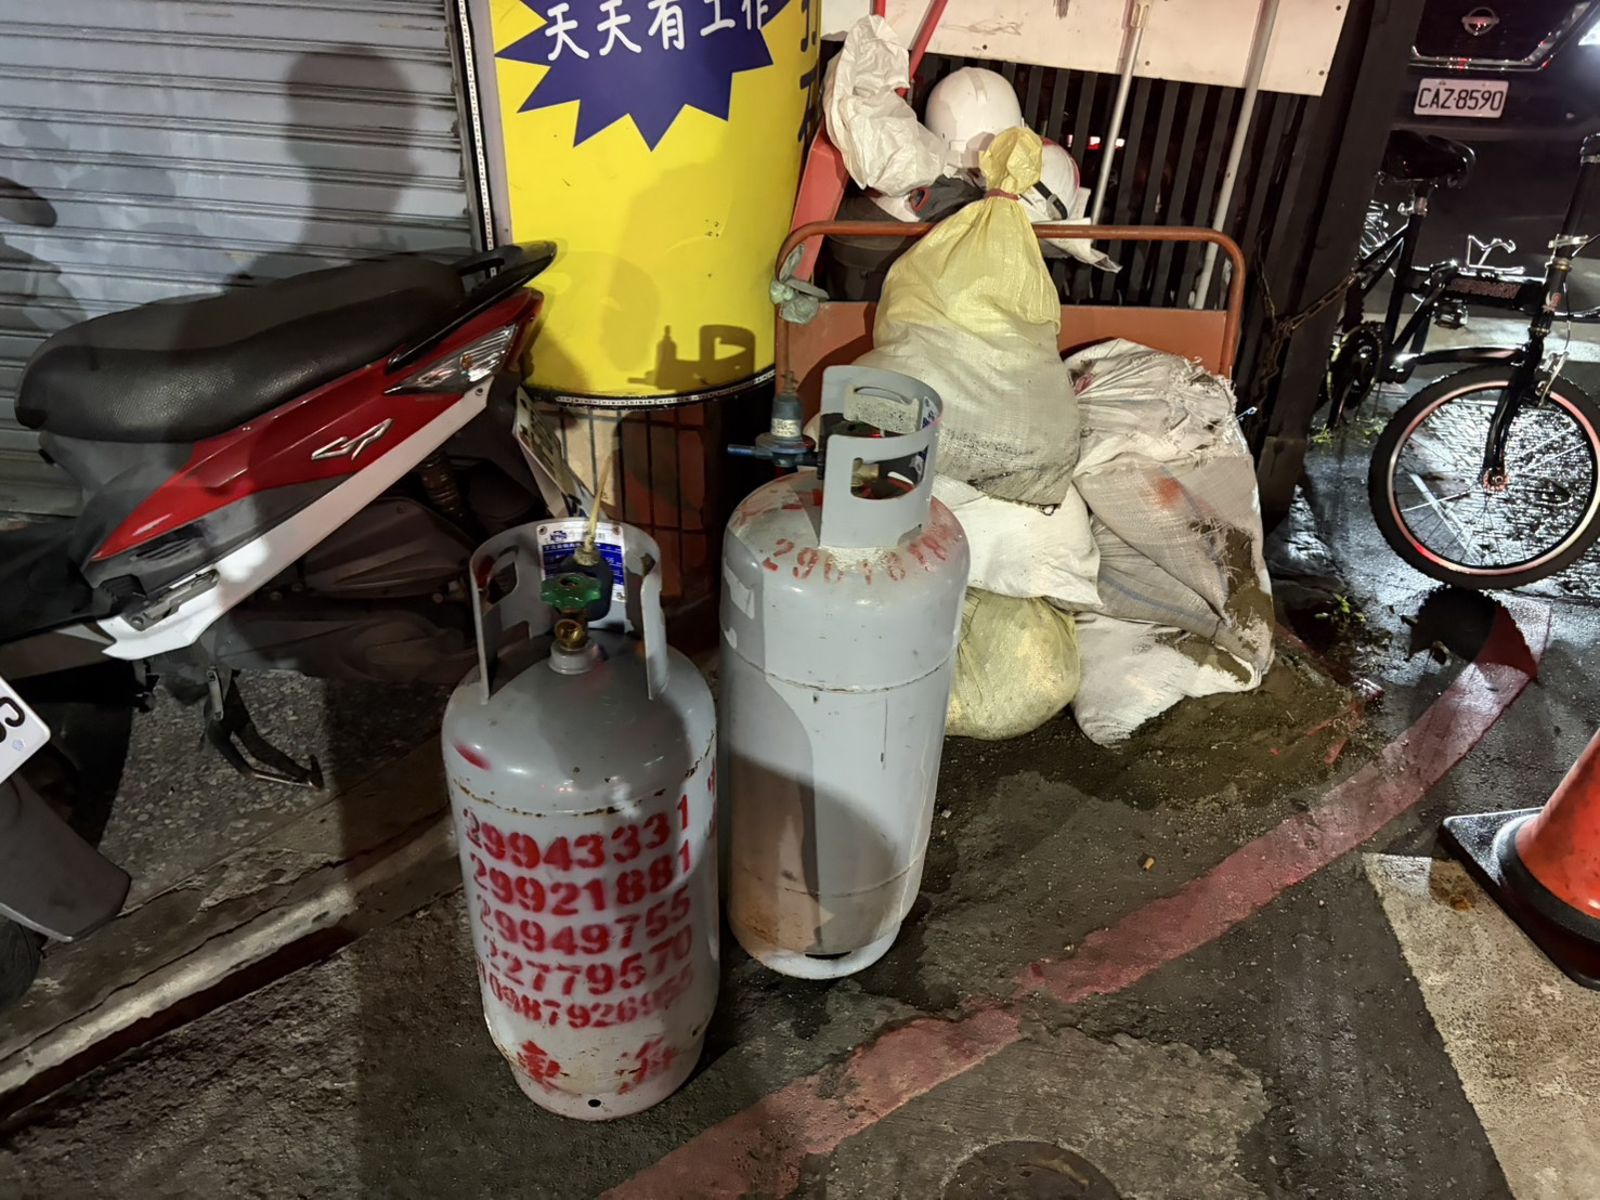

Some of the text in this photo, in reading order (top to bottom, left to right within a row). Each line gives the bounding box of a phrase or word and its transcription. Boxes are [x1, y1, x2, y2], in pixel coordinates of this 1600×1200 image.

[463, 794, 689, 872] 29943331
[469, 839, 691, 917] 29921881
[476, 884, 692, 956] 29949755
